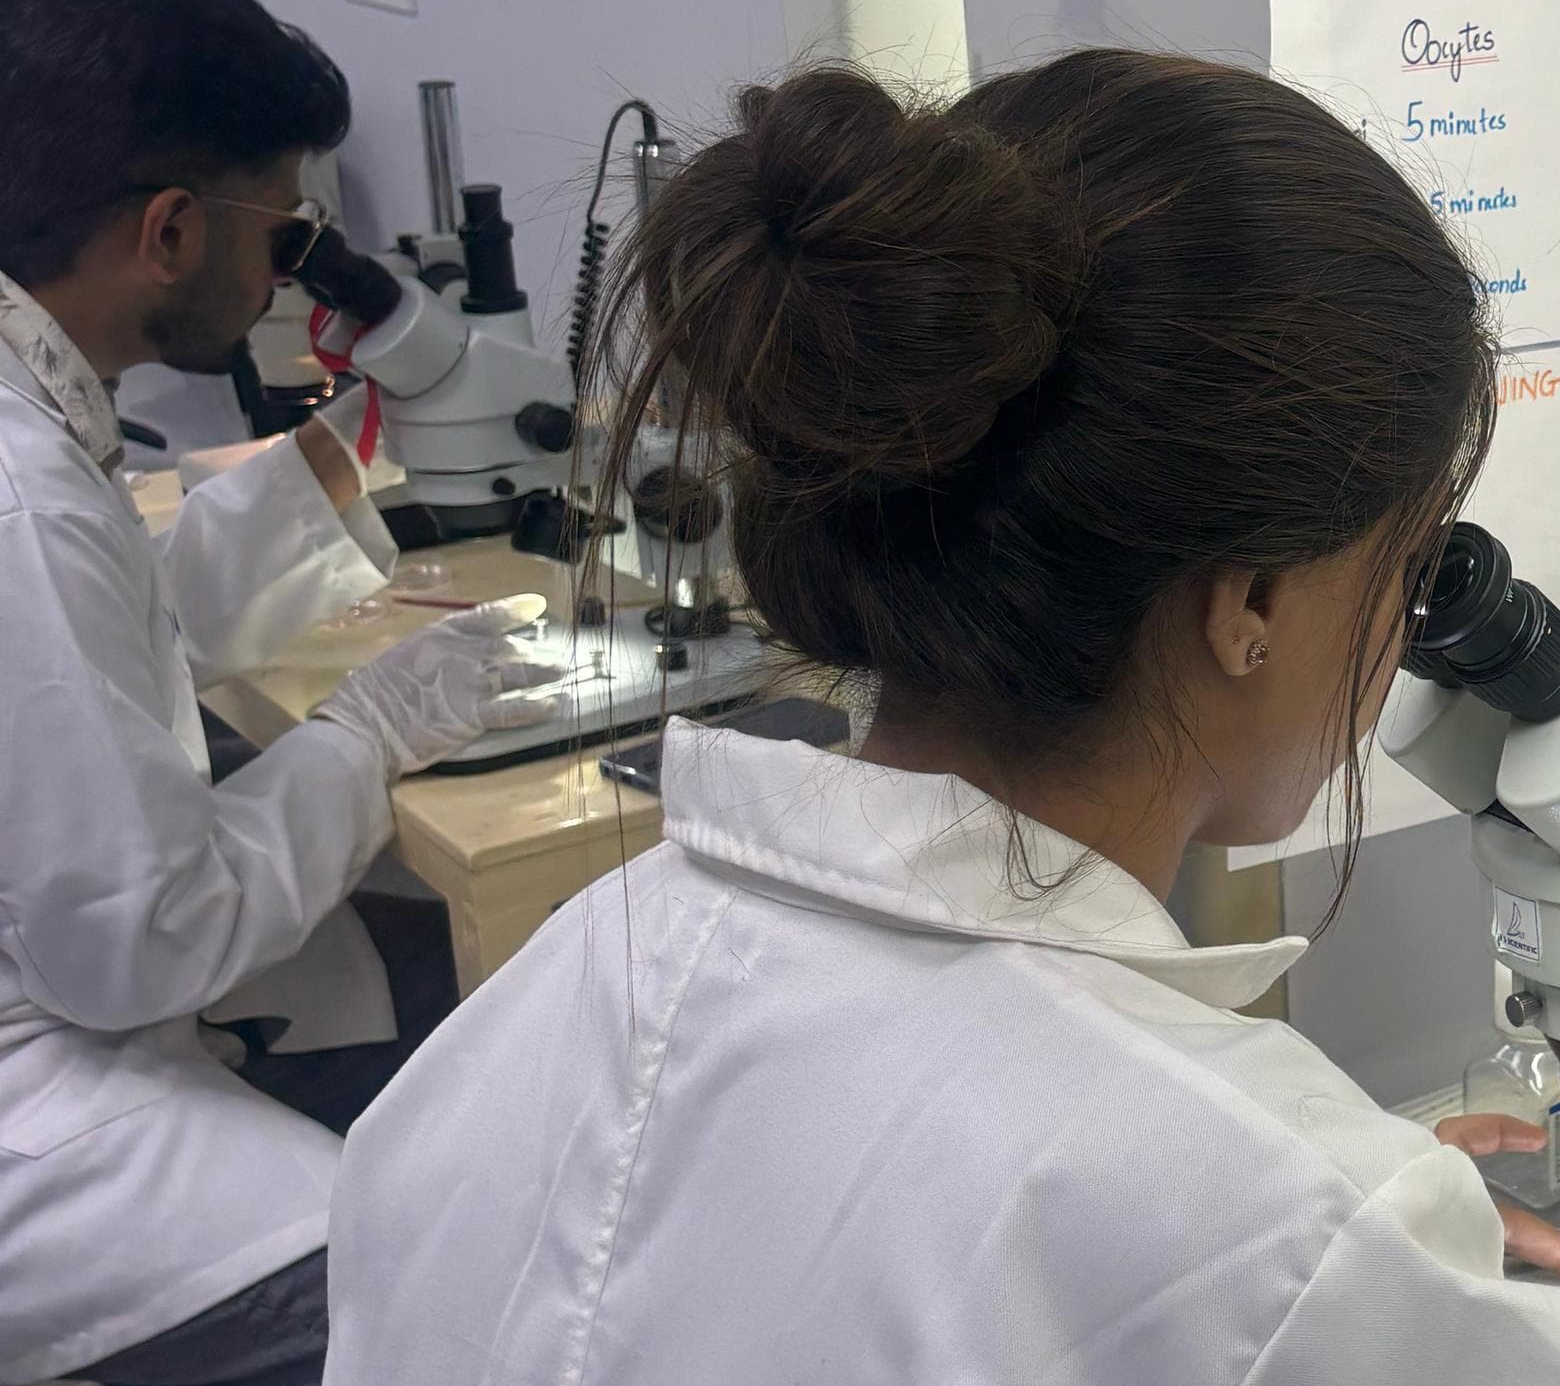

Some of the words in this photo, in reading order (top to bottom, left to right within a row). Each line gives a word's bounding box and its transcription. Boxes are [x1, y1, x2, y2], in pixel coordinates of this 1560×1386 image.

[1401, 18, 1495, 83] Oocytes
[1401, 101, 1424, 142] 5
[1429, 107, 1507, 137] minutes
[1449, 187, 1517, 214] minutes
